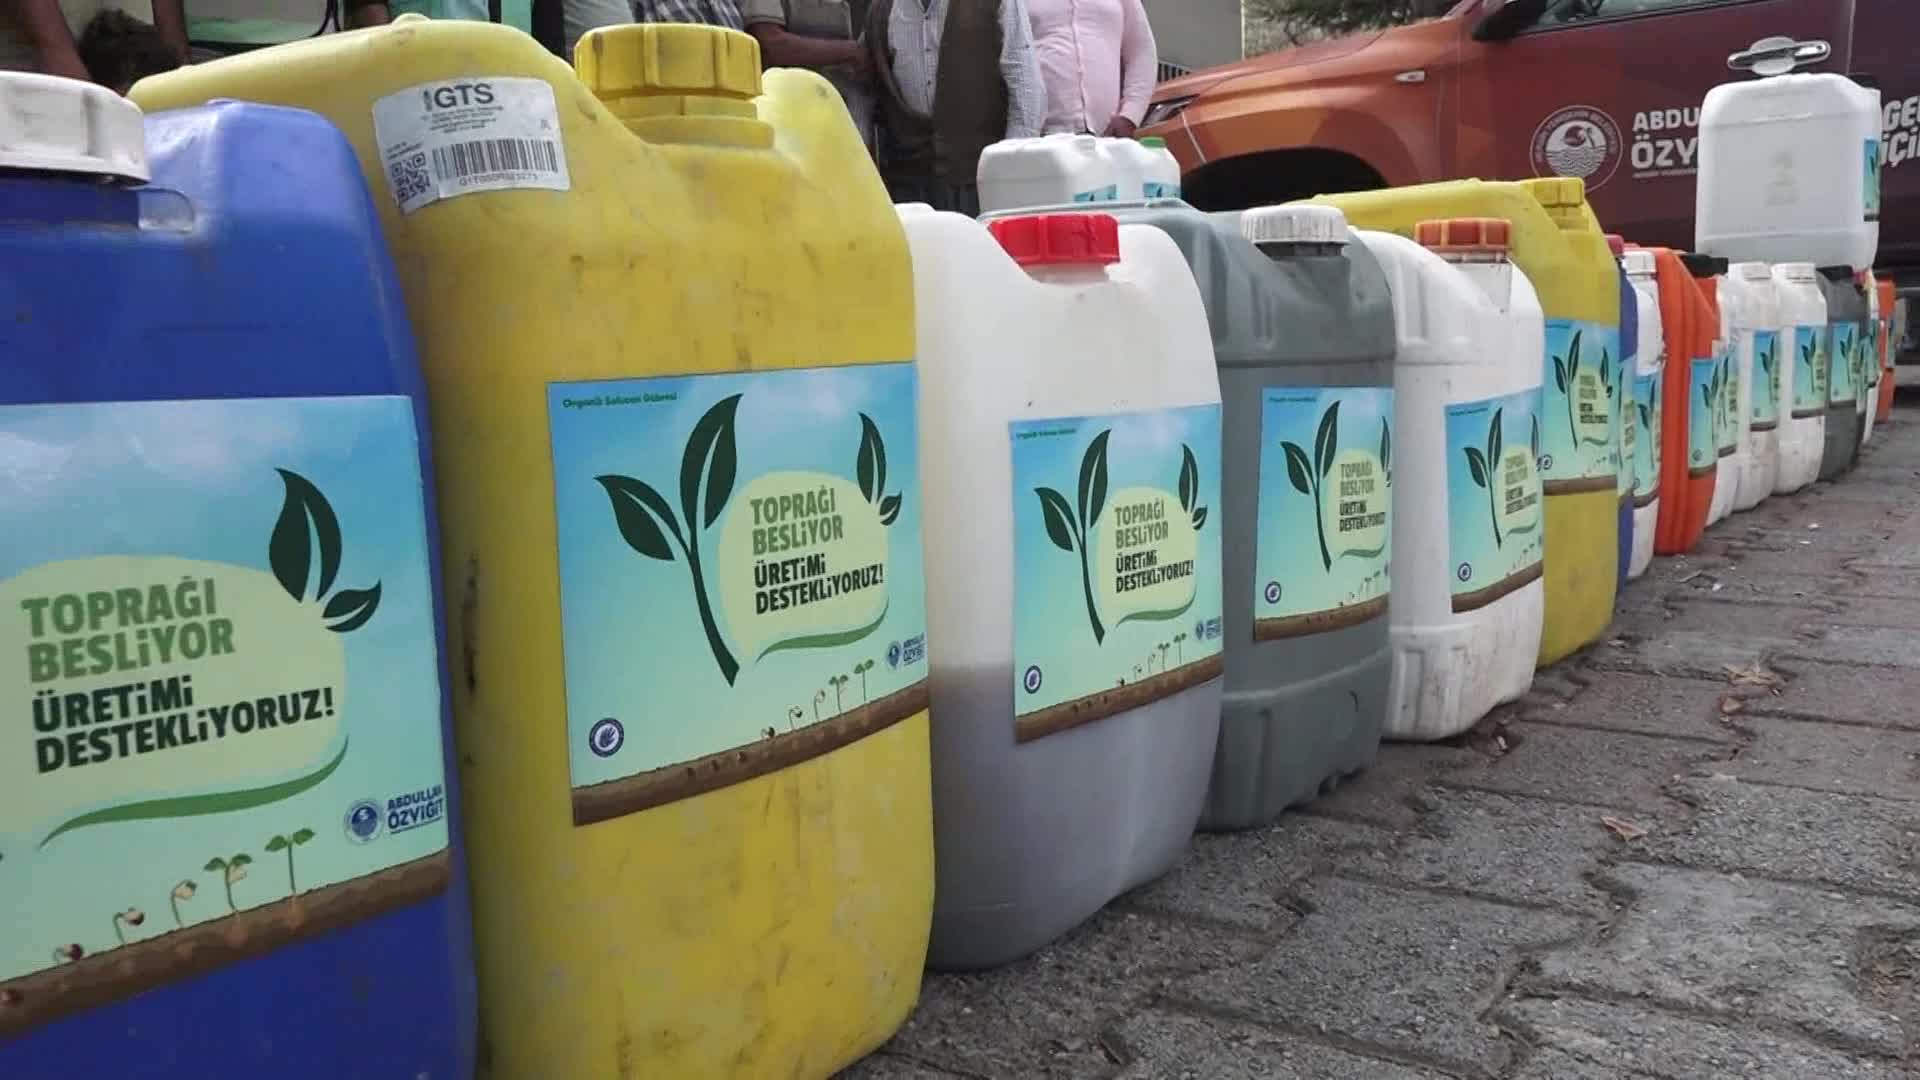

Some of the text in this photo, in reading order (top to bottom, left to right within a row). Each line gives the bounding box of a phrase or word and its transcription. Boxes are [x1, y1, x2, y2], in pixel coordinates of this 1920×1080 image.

[434, 83, 494, 108] GTS
[750, 484, 836, 526] TOPRAĞI
[1115, 499, 1165, 527] TOPRAĞI
[21, 576, 217, 638] TOPRAĞI
